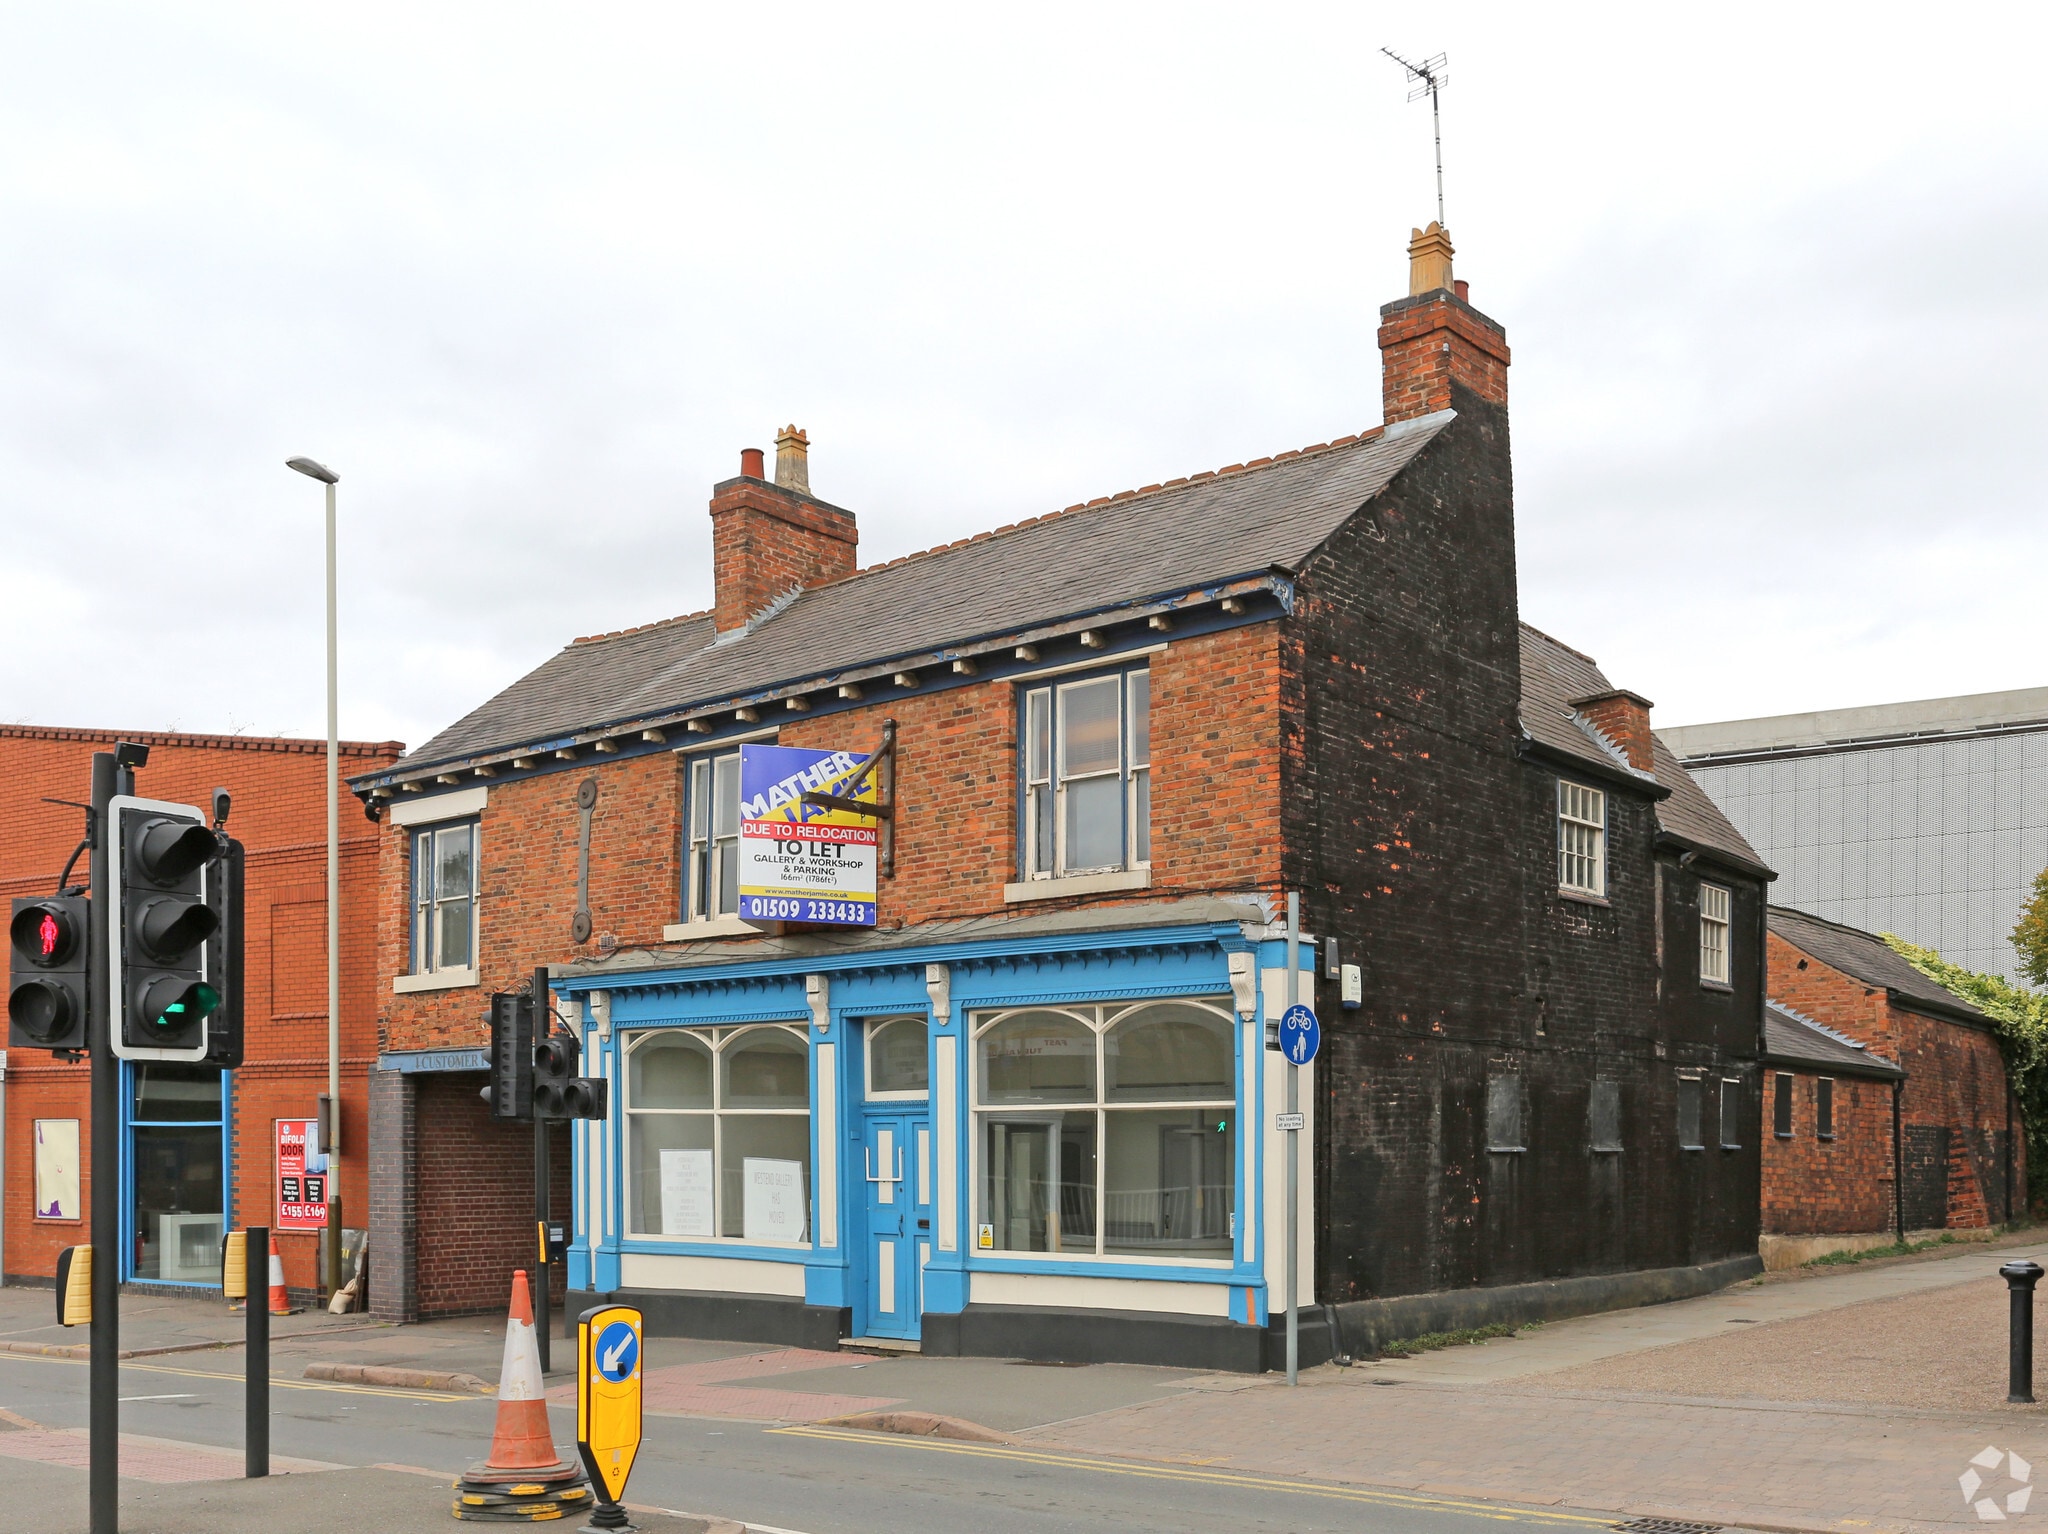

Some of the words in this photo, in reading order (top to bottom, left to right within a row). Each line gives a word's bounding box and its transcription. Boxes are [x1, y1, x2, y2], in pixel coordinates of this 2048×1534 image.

[741, 751, 857, 820] MATHER
[743, 823, 771, 835] DUE
[774, 824, 793, 837] TO
[796, 826, 876, 842] RELOCATION
[773, 839, 803, 855] TO
[810, 842, 845, 858] LET
[754, 854, 796, 864] GALLERY
[799, 857, 806, 865] &
[809, 857, 864, 869] WORKSHOP
[783, 865, 791, 873] &
[793, 866, 836, 876] PARKING
[765, 888, 848, 899] www.matherjamie.co.uk
[751, 898, 801, 919] 01509
[807, 901, 865, 922] 233433
[422, 1055, 477, 1069] CUSTOMER
[281, 1135, 305, 1144] BIFOLD
[281, 1145, 304, 1156] DOOR
[775, 1173, 793, 1187] GALLERY
[771, 1191, 781, 1205] HAS
[282, 1204, 302, 1217] £155
[304, 1204, 326, 1219] £169
[768, 1210, 785, 1225] MOVED
